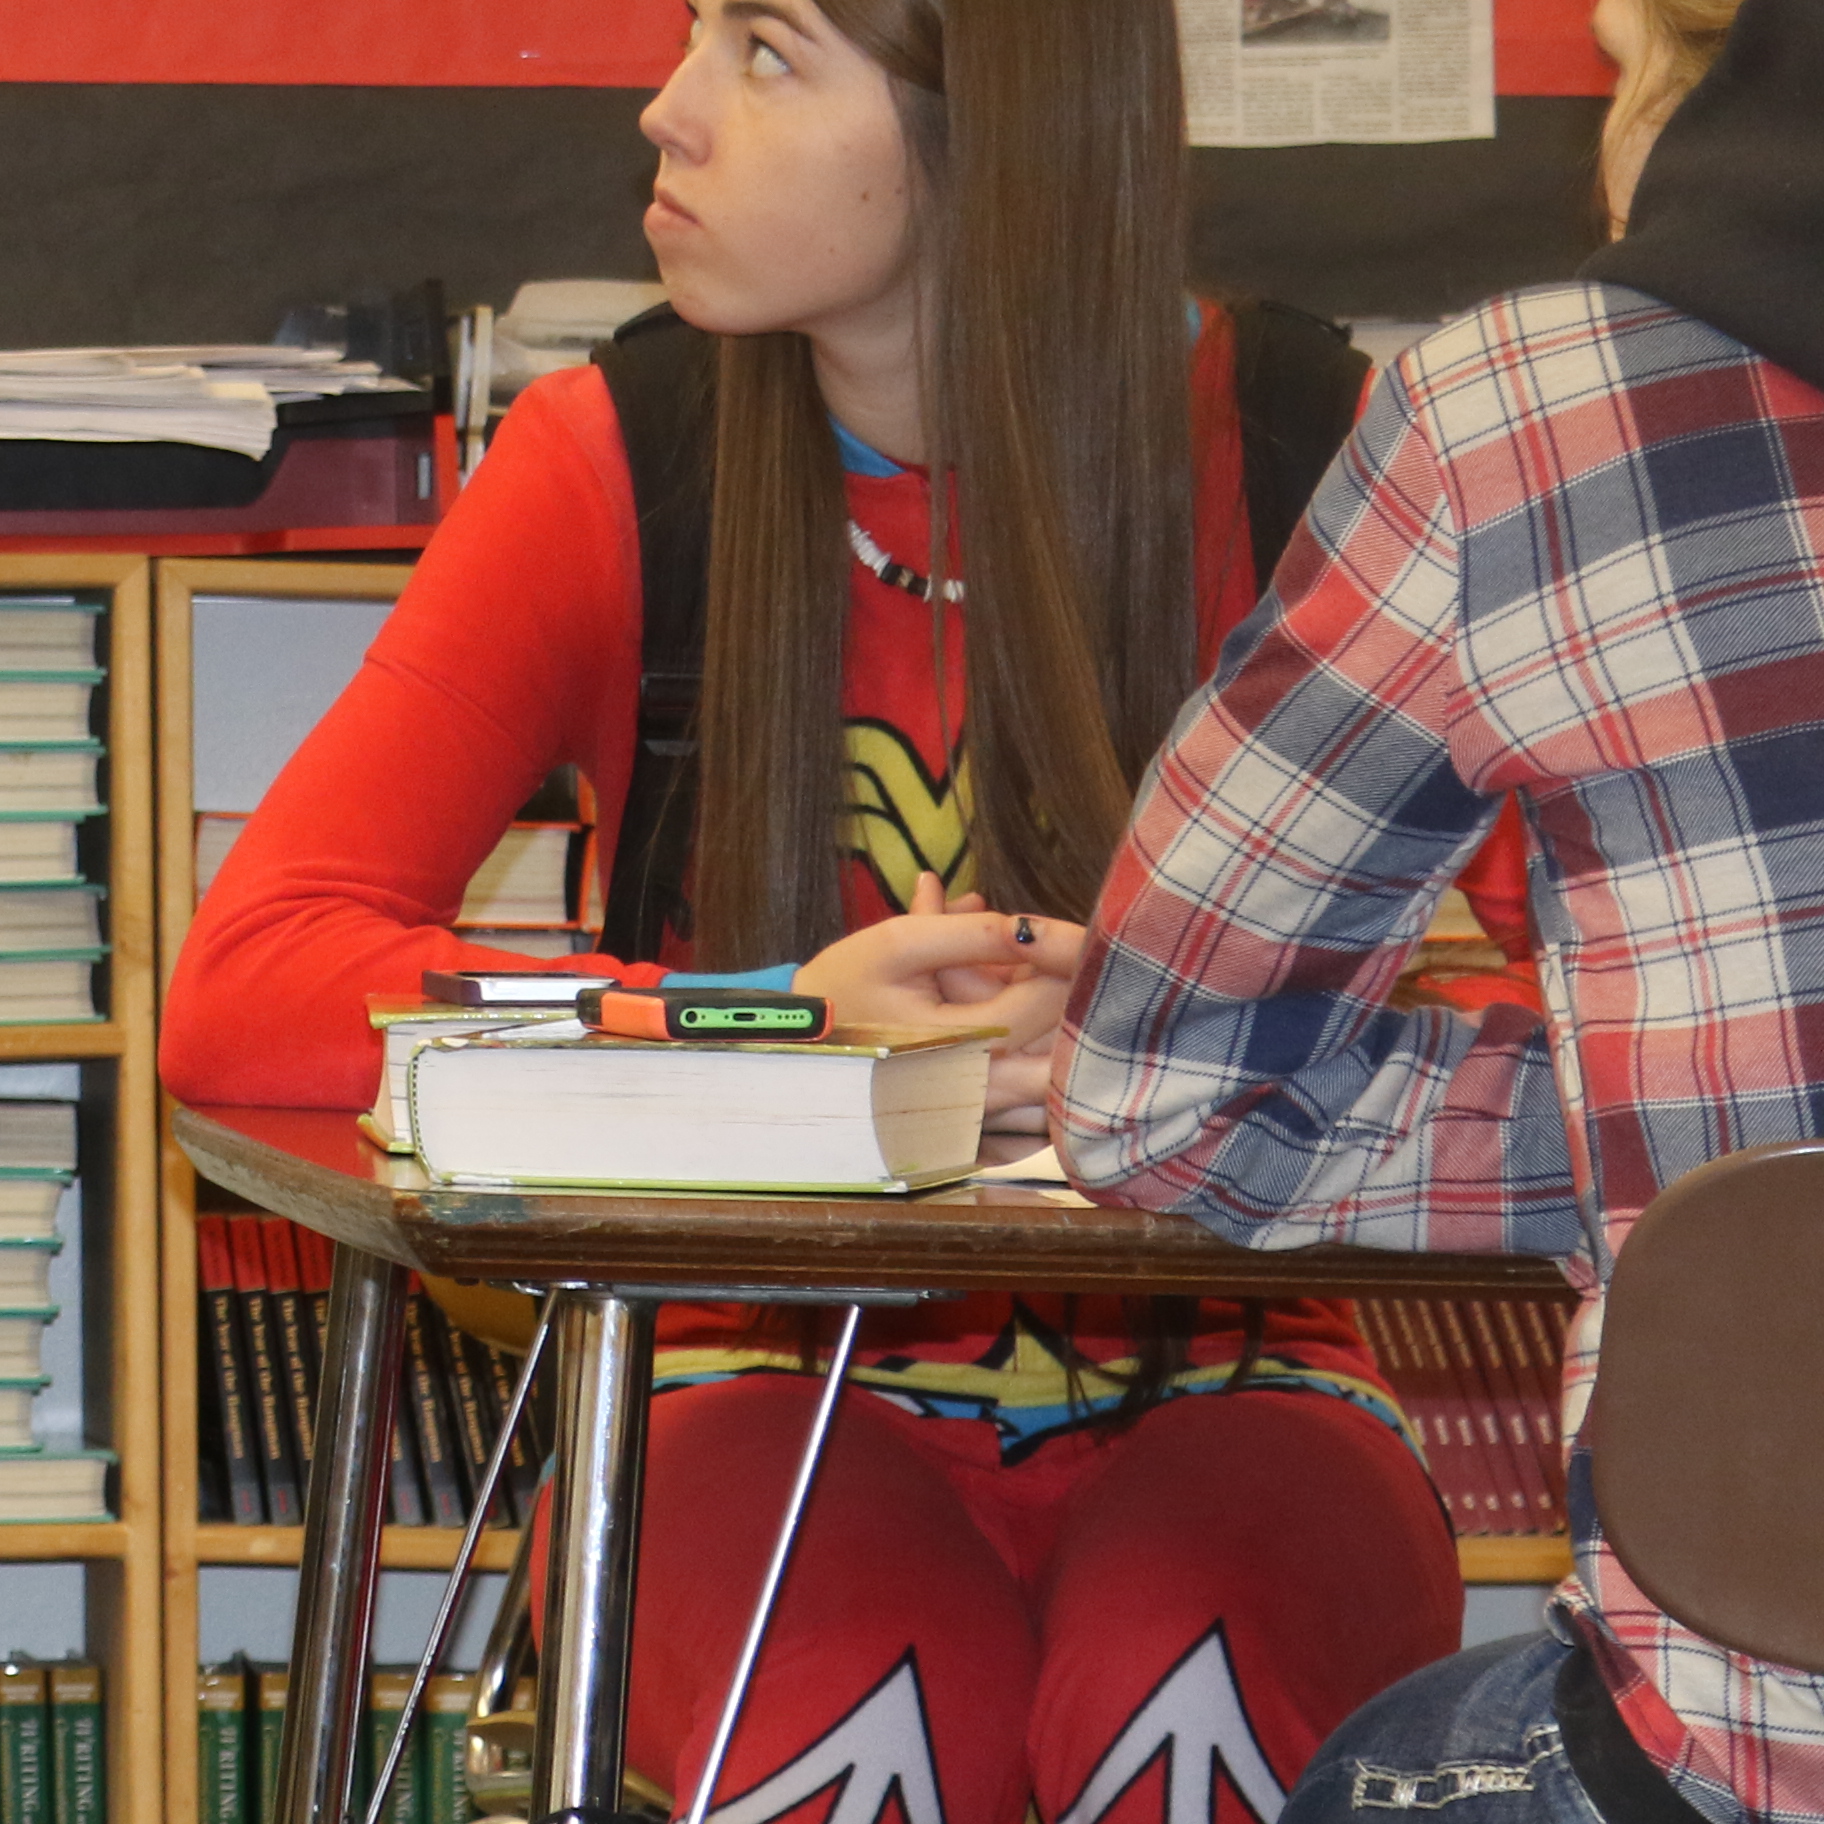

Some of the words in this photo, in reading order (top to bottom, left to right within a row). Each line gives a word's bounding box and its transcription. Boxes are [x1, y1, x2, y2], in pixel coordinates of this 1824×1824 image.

[20, 1718, 40, 1813] WRITING
[75, 1717, 96, 1813] WRITING
[219, 1726, 238, 1820] WRITING
